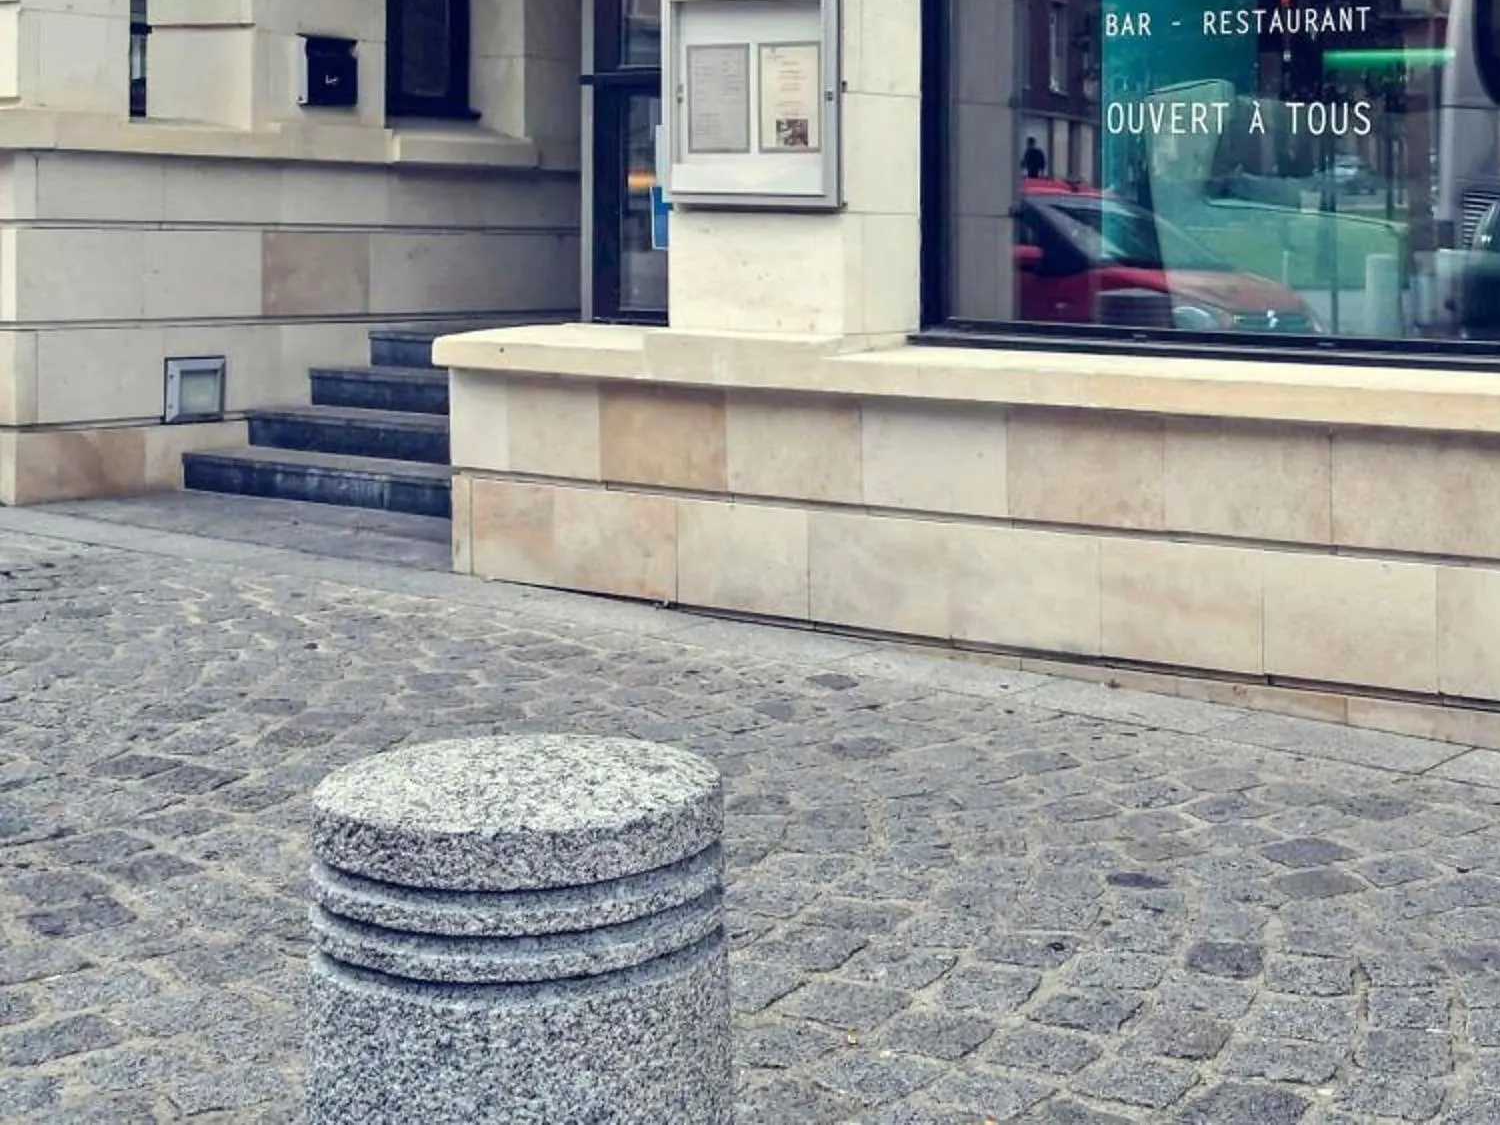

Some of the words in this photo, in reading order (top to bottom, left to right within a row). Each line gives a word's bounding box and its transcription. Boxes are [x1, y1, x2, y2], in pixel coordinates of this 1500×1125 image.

[1106, 12, 1151, 36] BAR
[1203, 6, 1371, 36] RESTAURANT
[1107, 102, 1229, 135] OUVERT
[1249, 101, 1265, 135] À
[1285, 102, 1372, 135] TOUS
